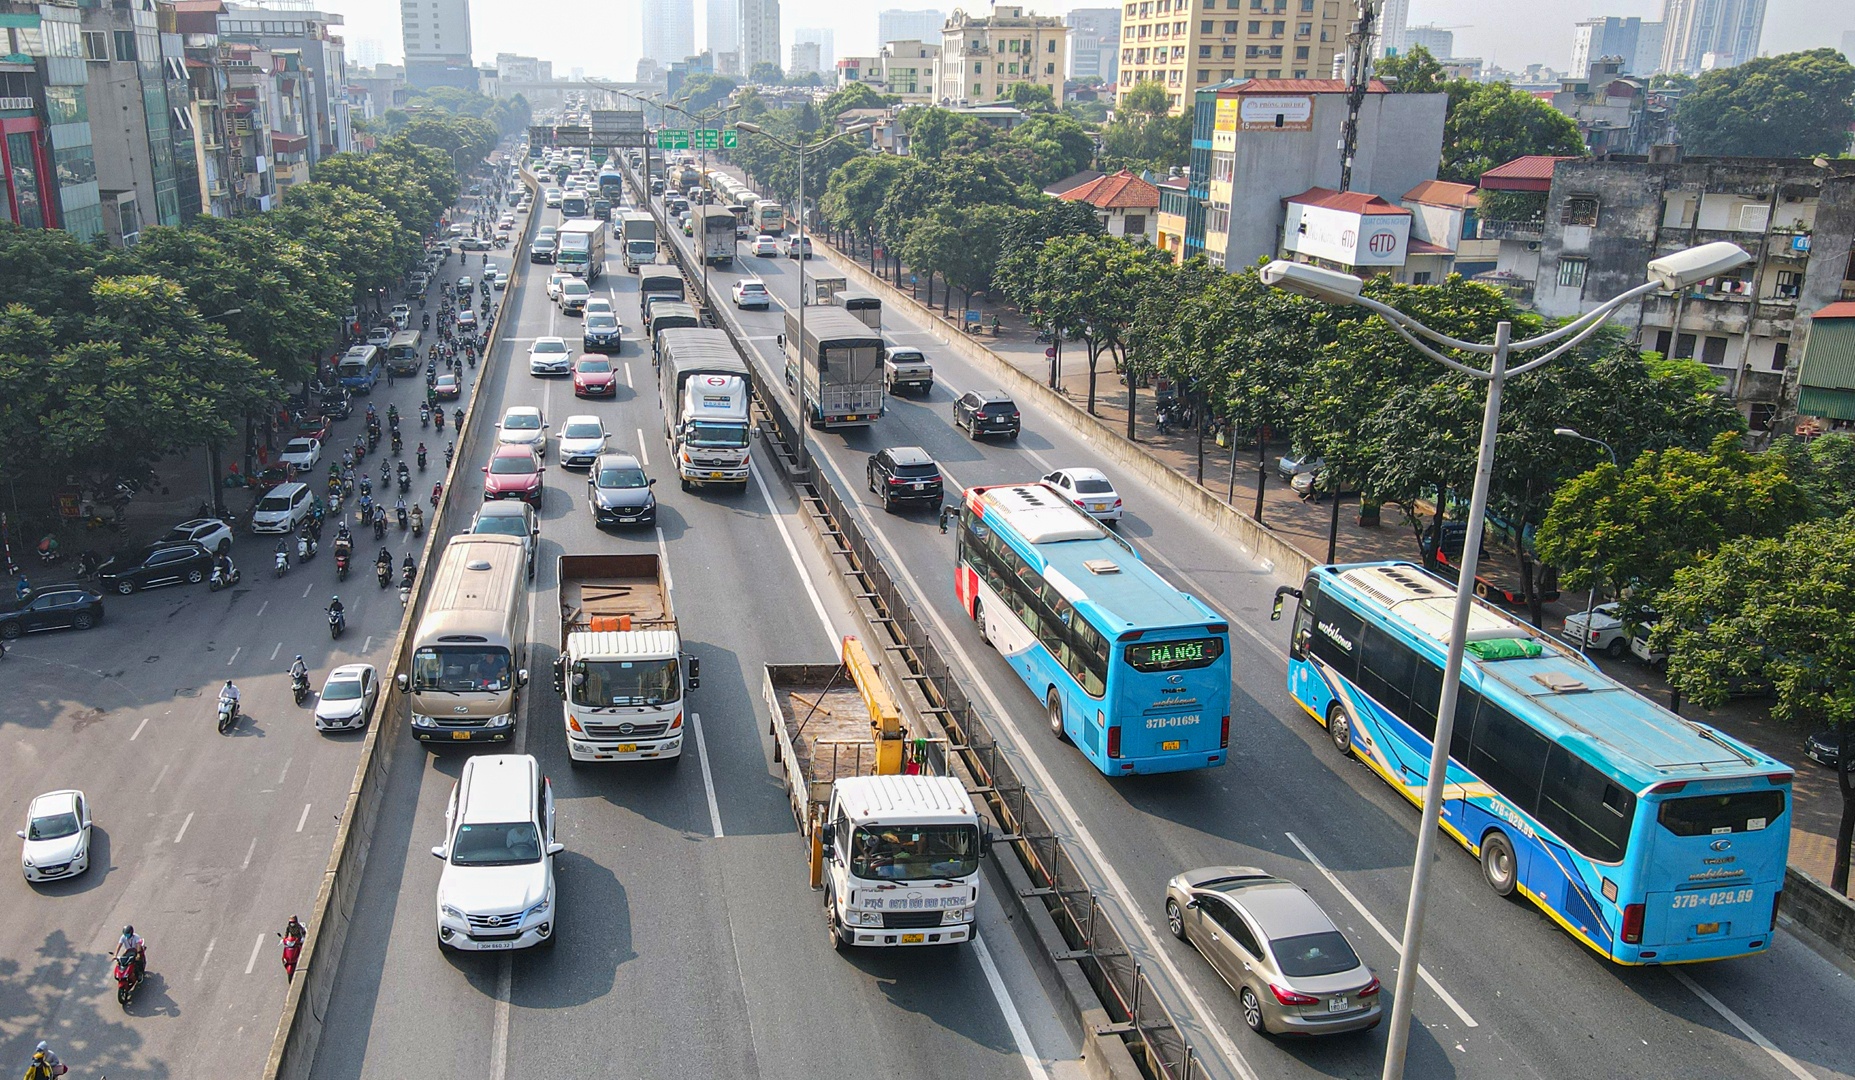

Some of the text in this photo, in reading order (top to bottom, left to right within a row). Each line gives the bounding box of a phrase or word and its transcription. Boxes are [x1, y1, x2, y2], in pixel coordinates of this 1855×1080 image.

[1341, 229, 1356, 249] ATD
[1369, 233, 1396, 252] ATD
[1151, 643, 1203, 661] HÀ NỘI
[1145, 714, 1200, 729] 37B-01694
